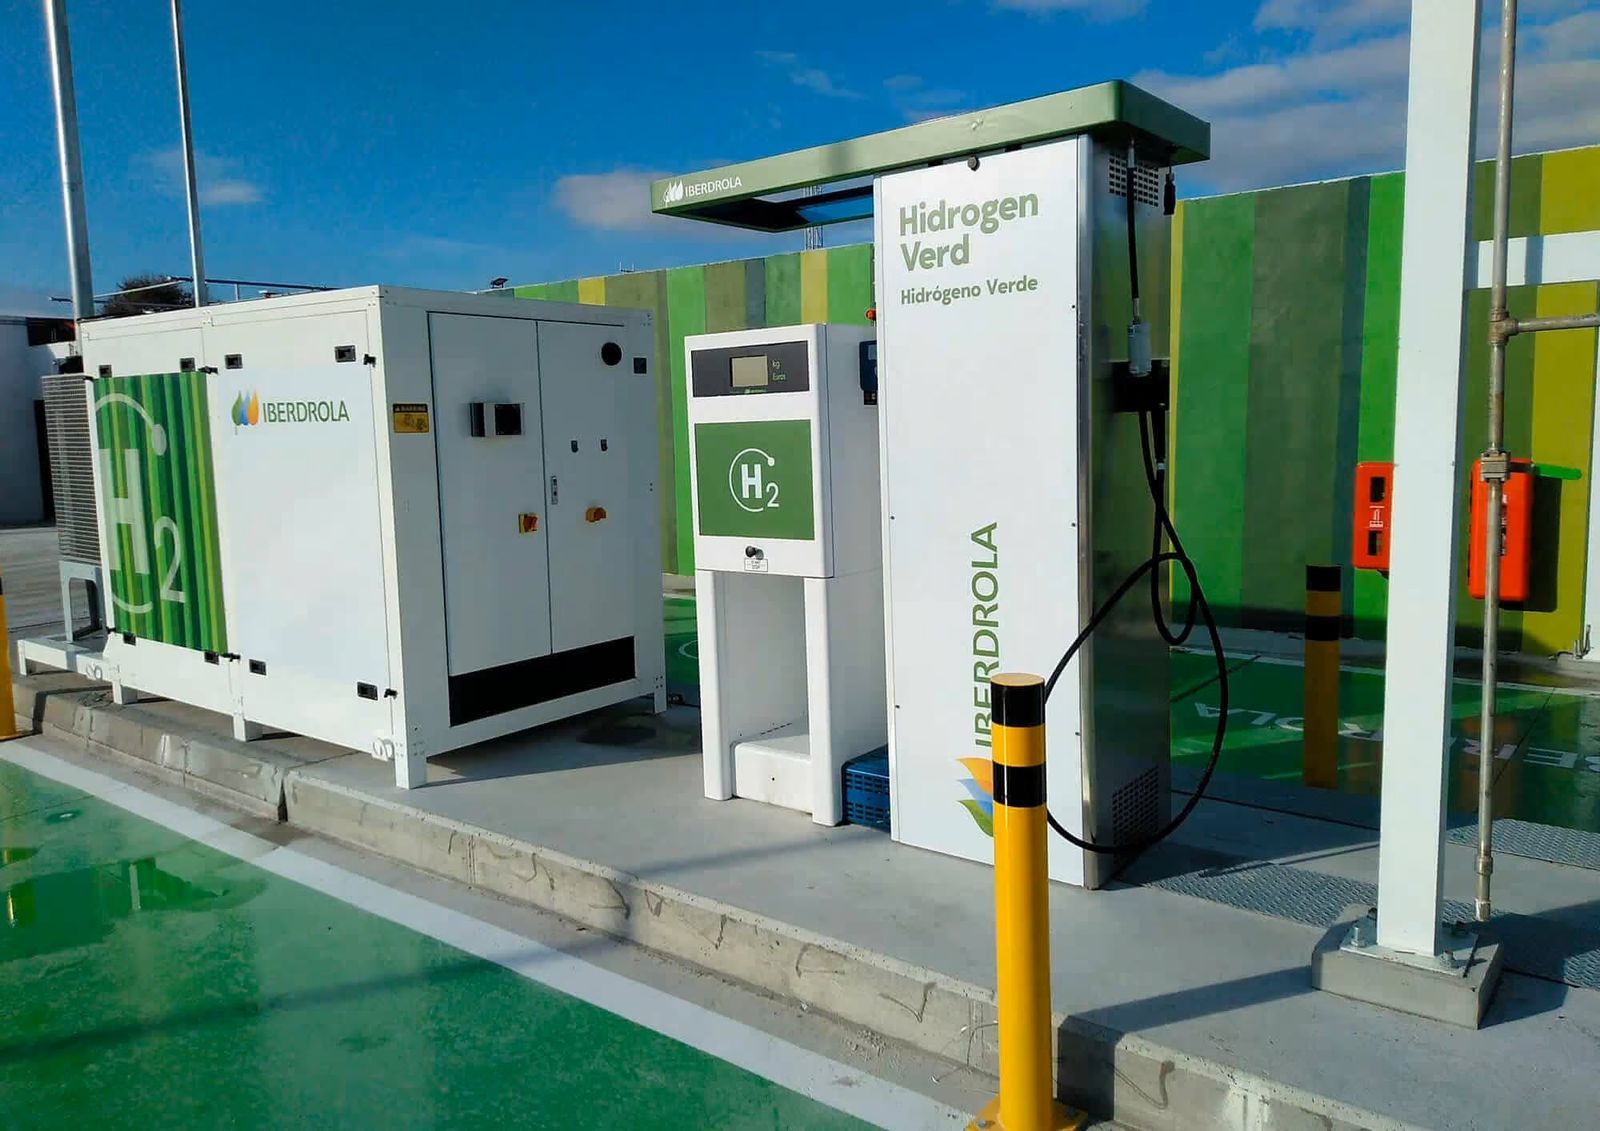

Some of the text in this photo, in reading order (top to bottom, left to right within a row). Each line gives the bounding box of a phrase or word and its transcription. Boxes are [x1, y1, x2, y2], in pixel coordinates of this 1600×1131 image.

[685, 176, 742, 198] IBERDROLA
[899, 192, 1039, 237] Hidrogen
[900, 234, 971, 272] Verd
[900, 275, 1039, 306] Hidrógeno Verde
[263, 400, 350, 424] IBERDROLA
